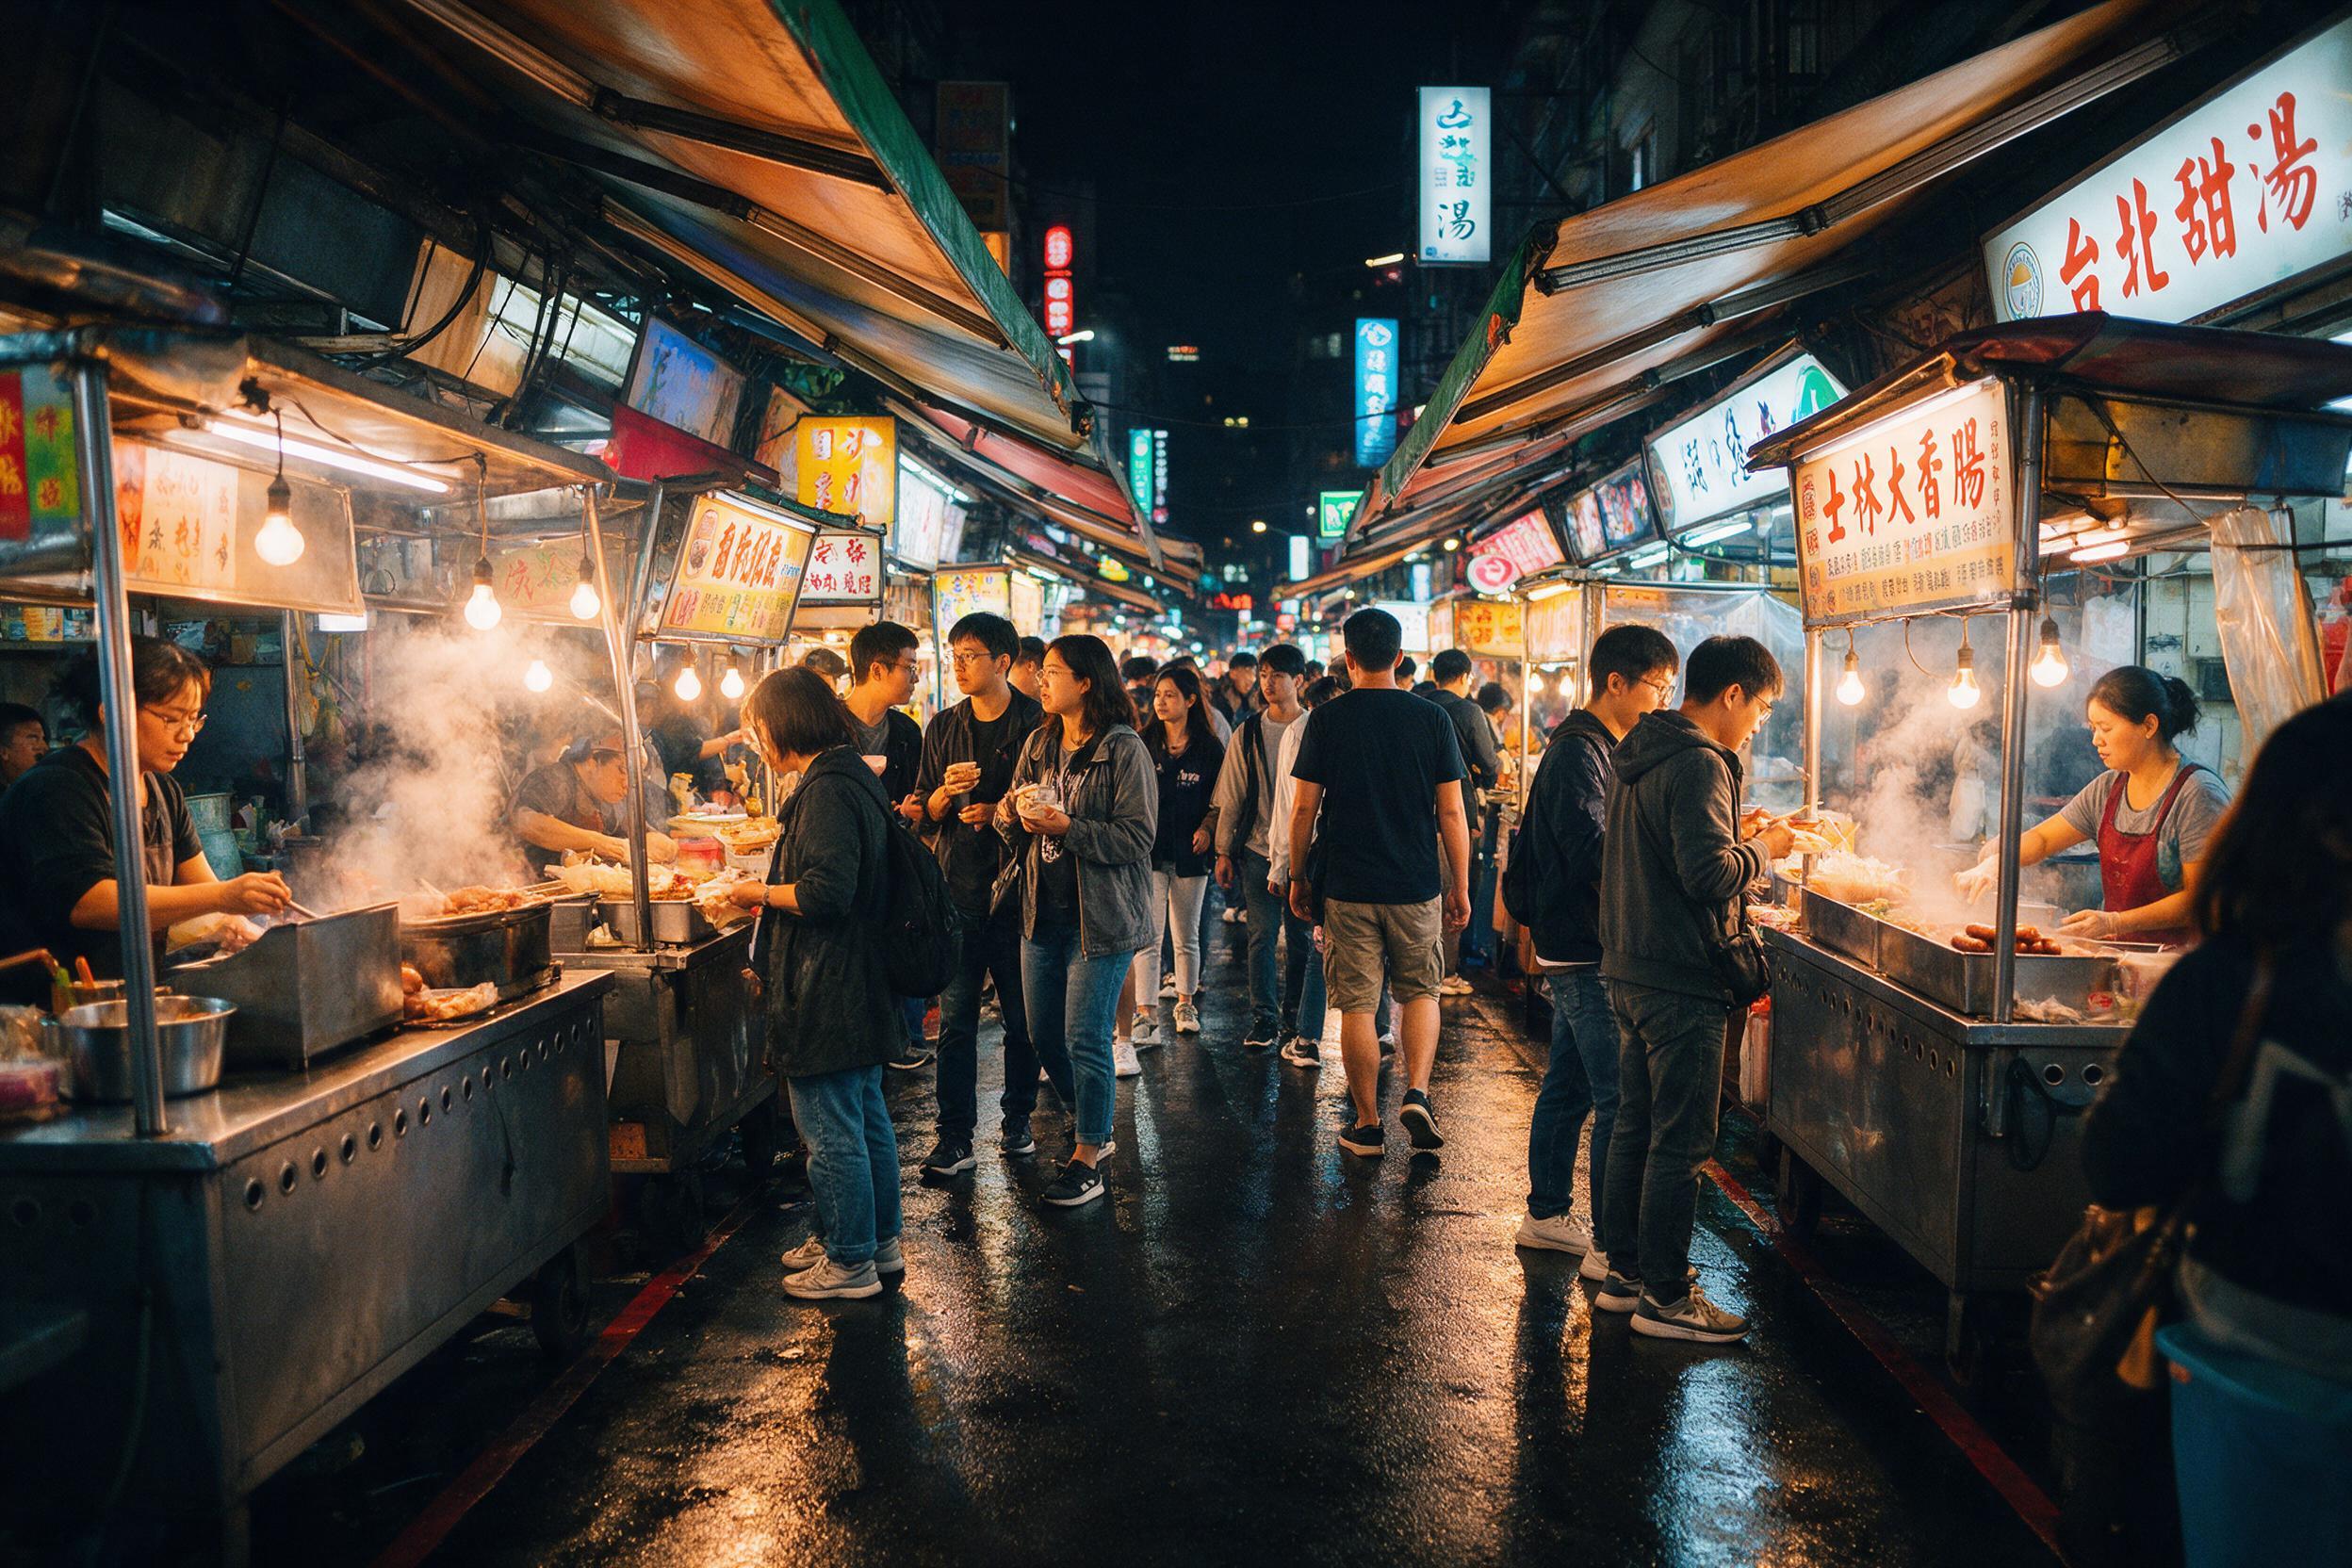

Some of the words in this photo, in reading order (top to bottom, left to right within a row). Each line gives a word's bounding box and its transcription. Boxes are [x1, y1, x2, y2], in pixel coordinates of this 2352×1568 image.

[2060, 91, 2318, 313] 台北甜湯
[1822, 416, 1985, 545] 士林大香腸
